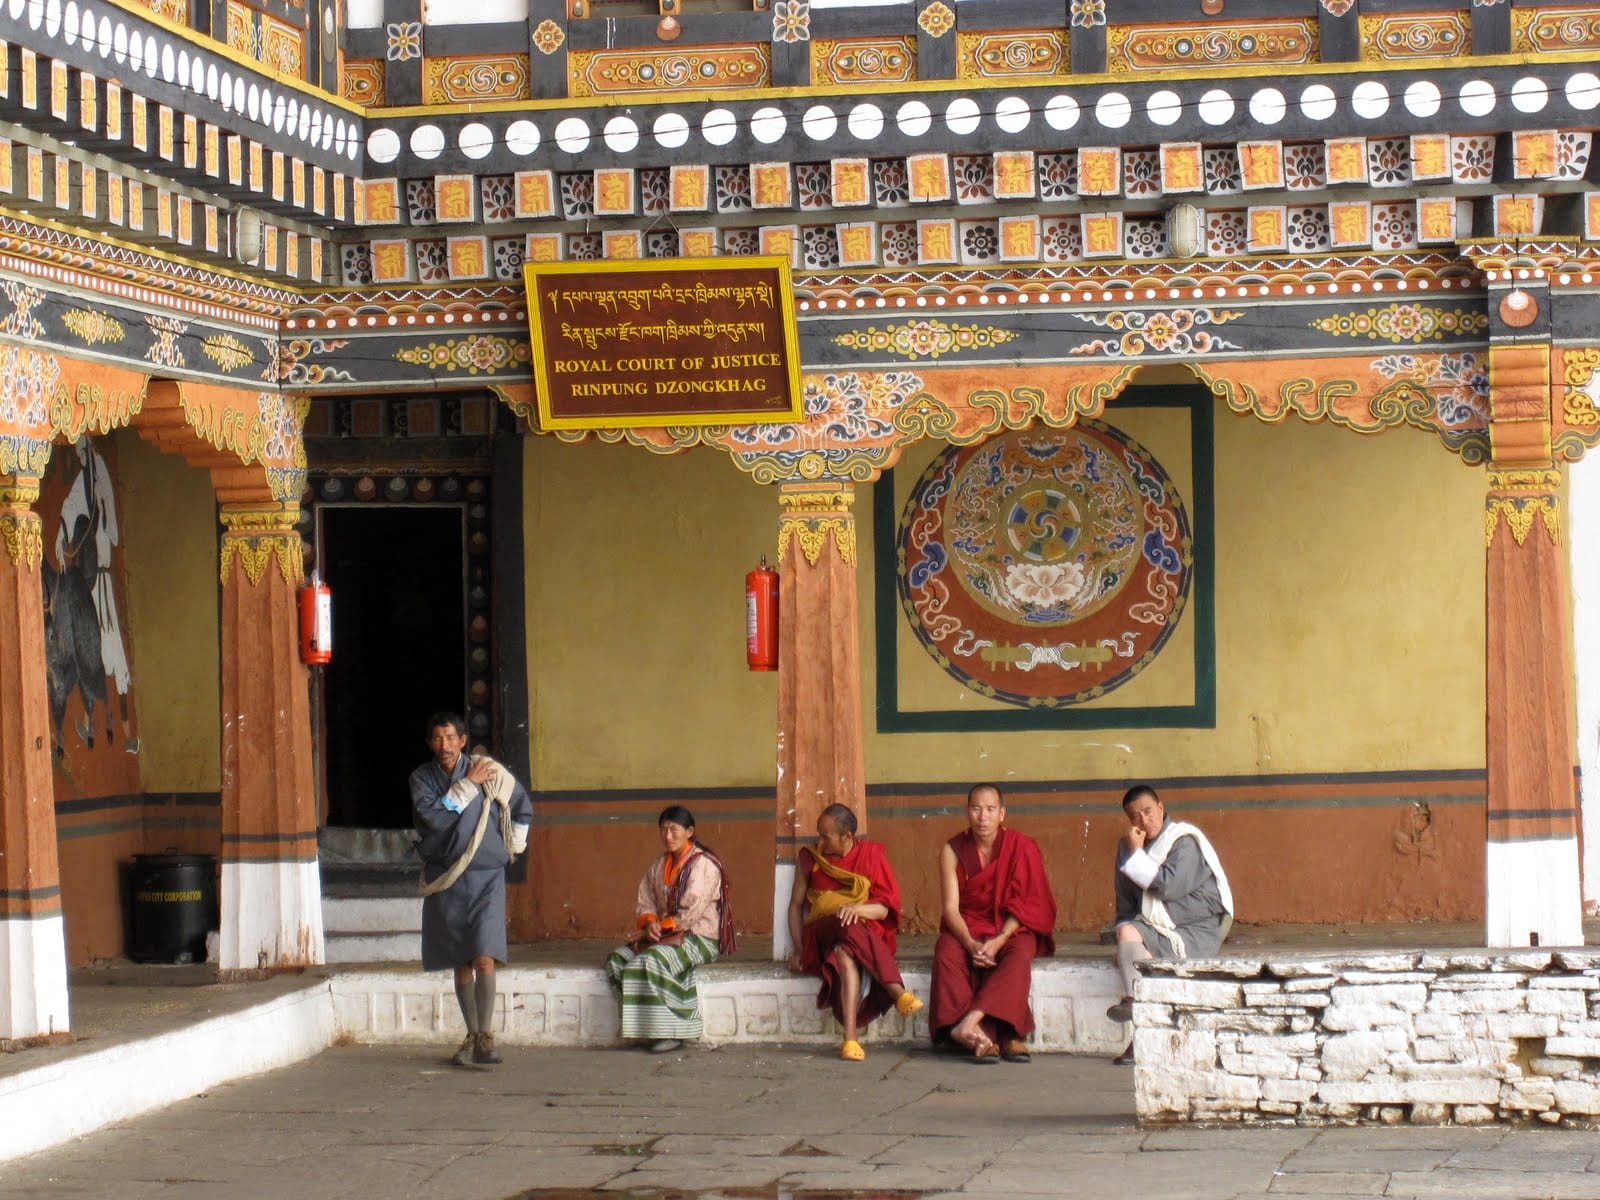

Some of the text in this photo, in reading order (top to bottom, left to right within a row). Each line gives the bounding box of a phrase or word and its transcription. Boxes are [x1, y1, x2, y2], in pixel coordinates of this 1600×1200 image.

[554, 353, 781, 373] ROYAL COURT OF JUSTICE
[571, 379, 766, 397] RINPUNG DZONGKHAG
